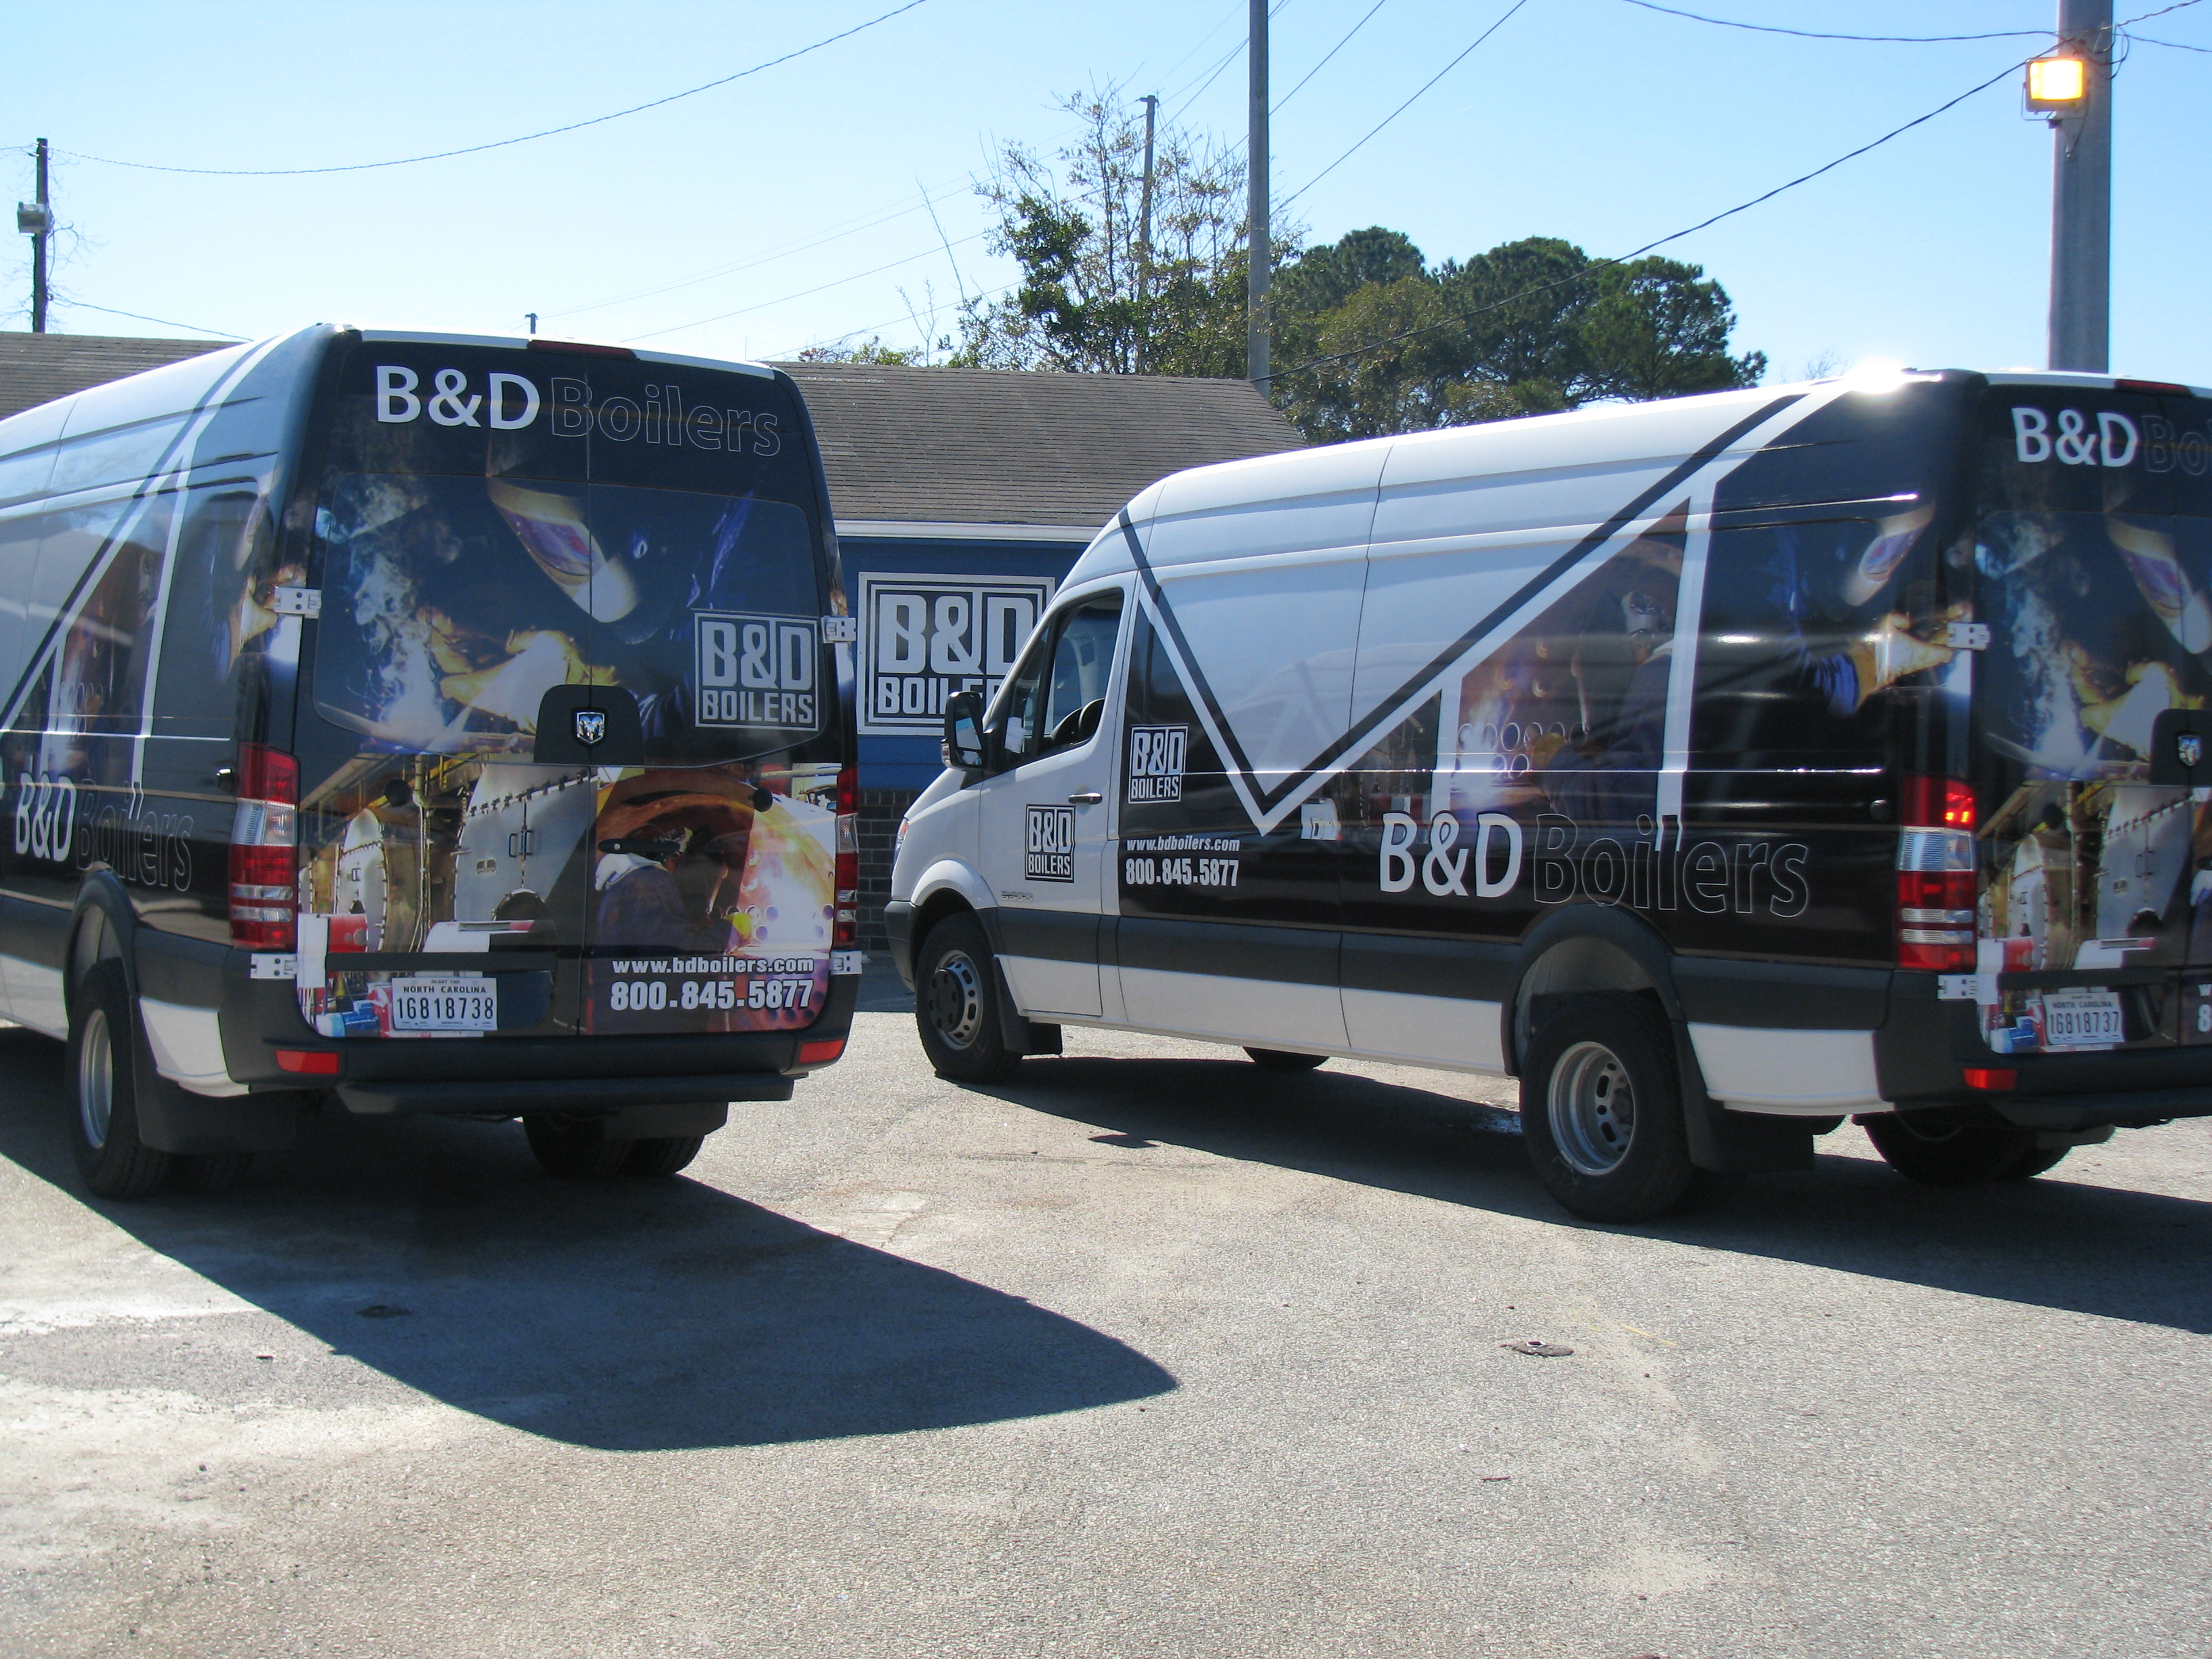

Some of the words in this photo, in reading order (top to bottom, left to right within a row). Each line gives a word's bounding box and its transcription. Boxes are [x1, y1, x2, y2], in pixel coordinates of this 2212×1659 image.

[376, 365, 541, 430] B&D
[550, 377, 781, 457] Boilers
[2011, 407, 2139, 468] B&D
[2141, 414, 2212, 476] Bo
[701, 621, 813, 691] B&D
[702, 689, 813, 724] BOILERS
[1132, 731, 1185, 777] B&D
[1131, 776, 1179, 799] BOILERS
[16, 771, 77, 863] B&D
[76, 778, 194, 893] Boilers
[1029, 811, 1071, 853] B&D
[1126, 835, 1241, 852] www.bdboilers.com
[1028, 854, 1071, 875] BOILERS
[1125, 858, 1240, 887] 800.845.5877
[1379, 812, 1523, 899] B&D
[1533, 813, 1809, 918] Boilers
[611, 956, 815, 975] www.bdboilers.com
[397, 997, 493, 1019] 16818738
[610, 979, 814, 1010] 800.845.5877
[2049, 1011, 2119, 1034] 16818737
